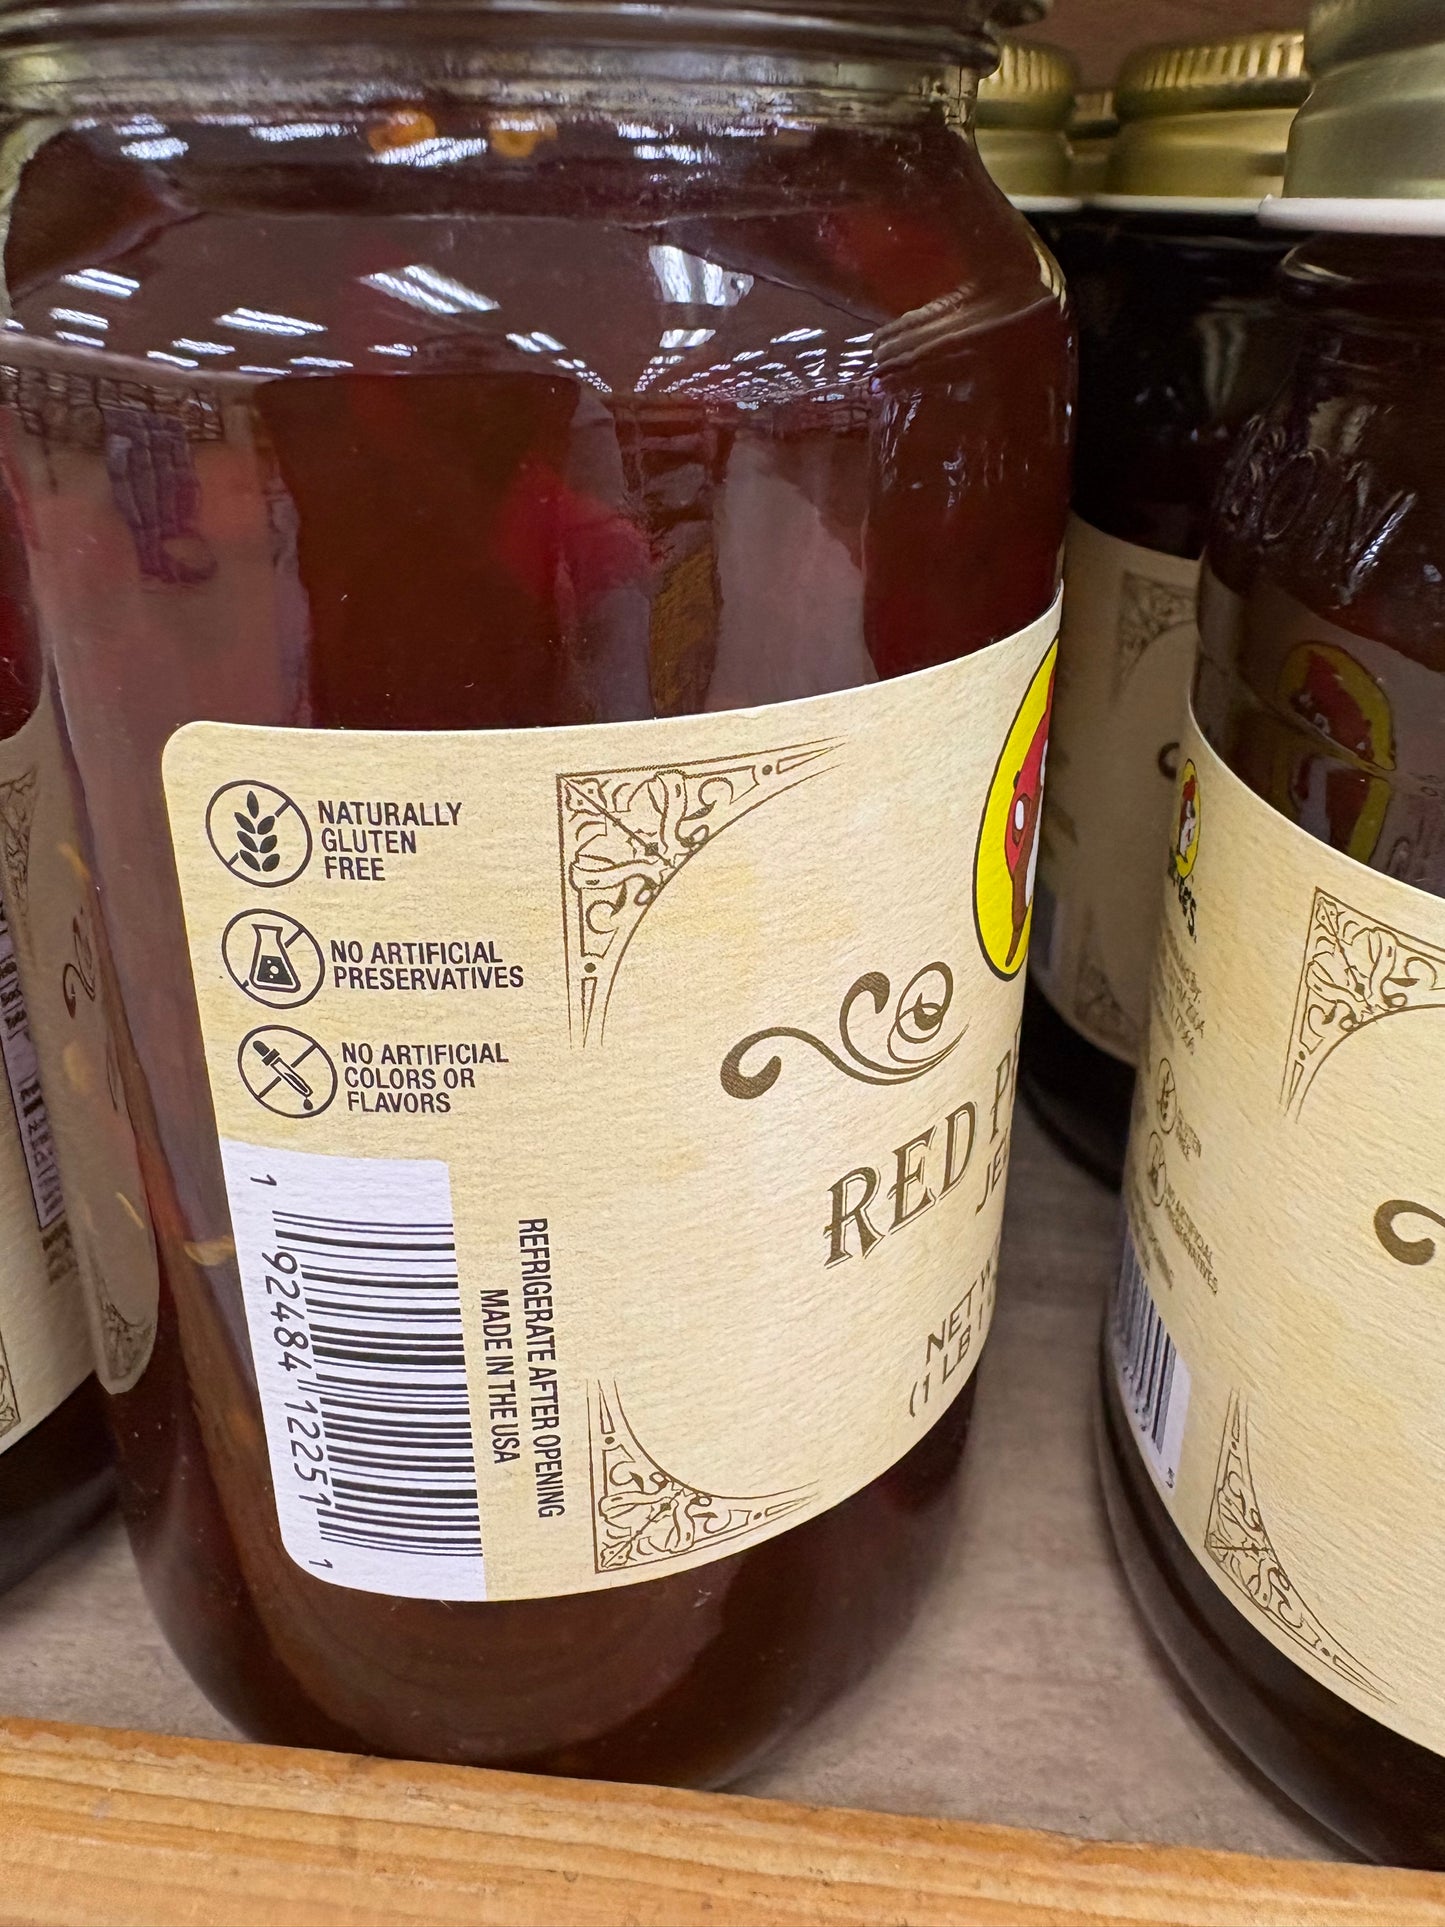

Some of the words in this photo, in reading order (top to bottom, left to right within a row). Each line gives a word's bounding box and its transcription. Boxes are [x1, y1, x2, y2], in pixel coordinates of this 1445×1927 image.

[318, 800, 463, 826] NATURALLY
[321, 828, 417, 854] GLUTEN
[324, 856, 386, 881] FREE
[330, 940, 363, 964] NO
[371, 940, 503, 965] ARTIFICIAL
[334, 965, 525, 991] PRESERVATIVES
[341, 1042, 373, 1064] NO
[381, 1042, 509, 1065] ARTIFICIAL
[344, 1067, 436, 1089] COLORS
[443, 1067, 476, 1089] OR
[347, 1091, 451, 1114] FLAVORS
[250, 1173, 278, 1187] 1
[824, 1099, 979, 1270] RED
[518, 1217, 557, 1363] REFRIGERATE
[261, 1250, 313, 1373] 92484
[480, 1289, 513, 1351] MADE
[925, 1279, 978, 1367] NET
[485, 1355, 515, 1376] IN
[909, 1372, 931, 1418] (1
[942, 1324, 972, 1385] LB
[488, 1379, 518, 1420] THE
[528, 1366, 560, 1431] AFTER
[283, 1398, 334, 1509] 12251
[490, 1423, 521, 1464] USA
[532, 1434, 566, 1519] OPENING
[308, 1557, 334, 1570] 1
